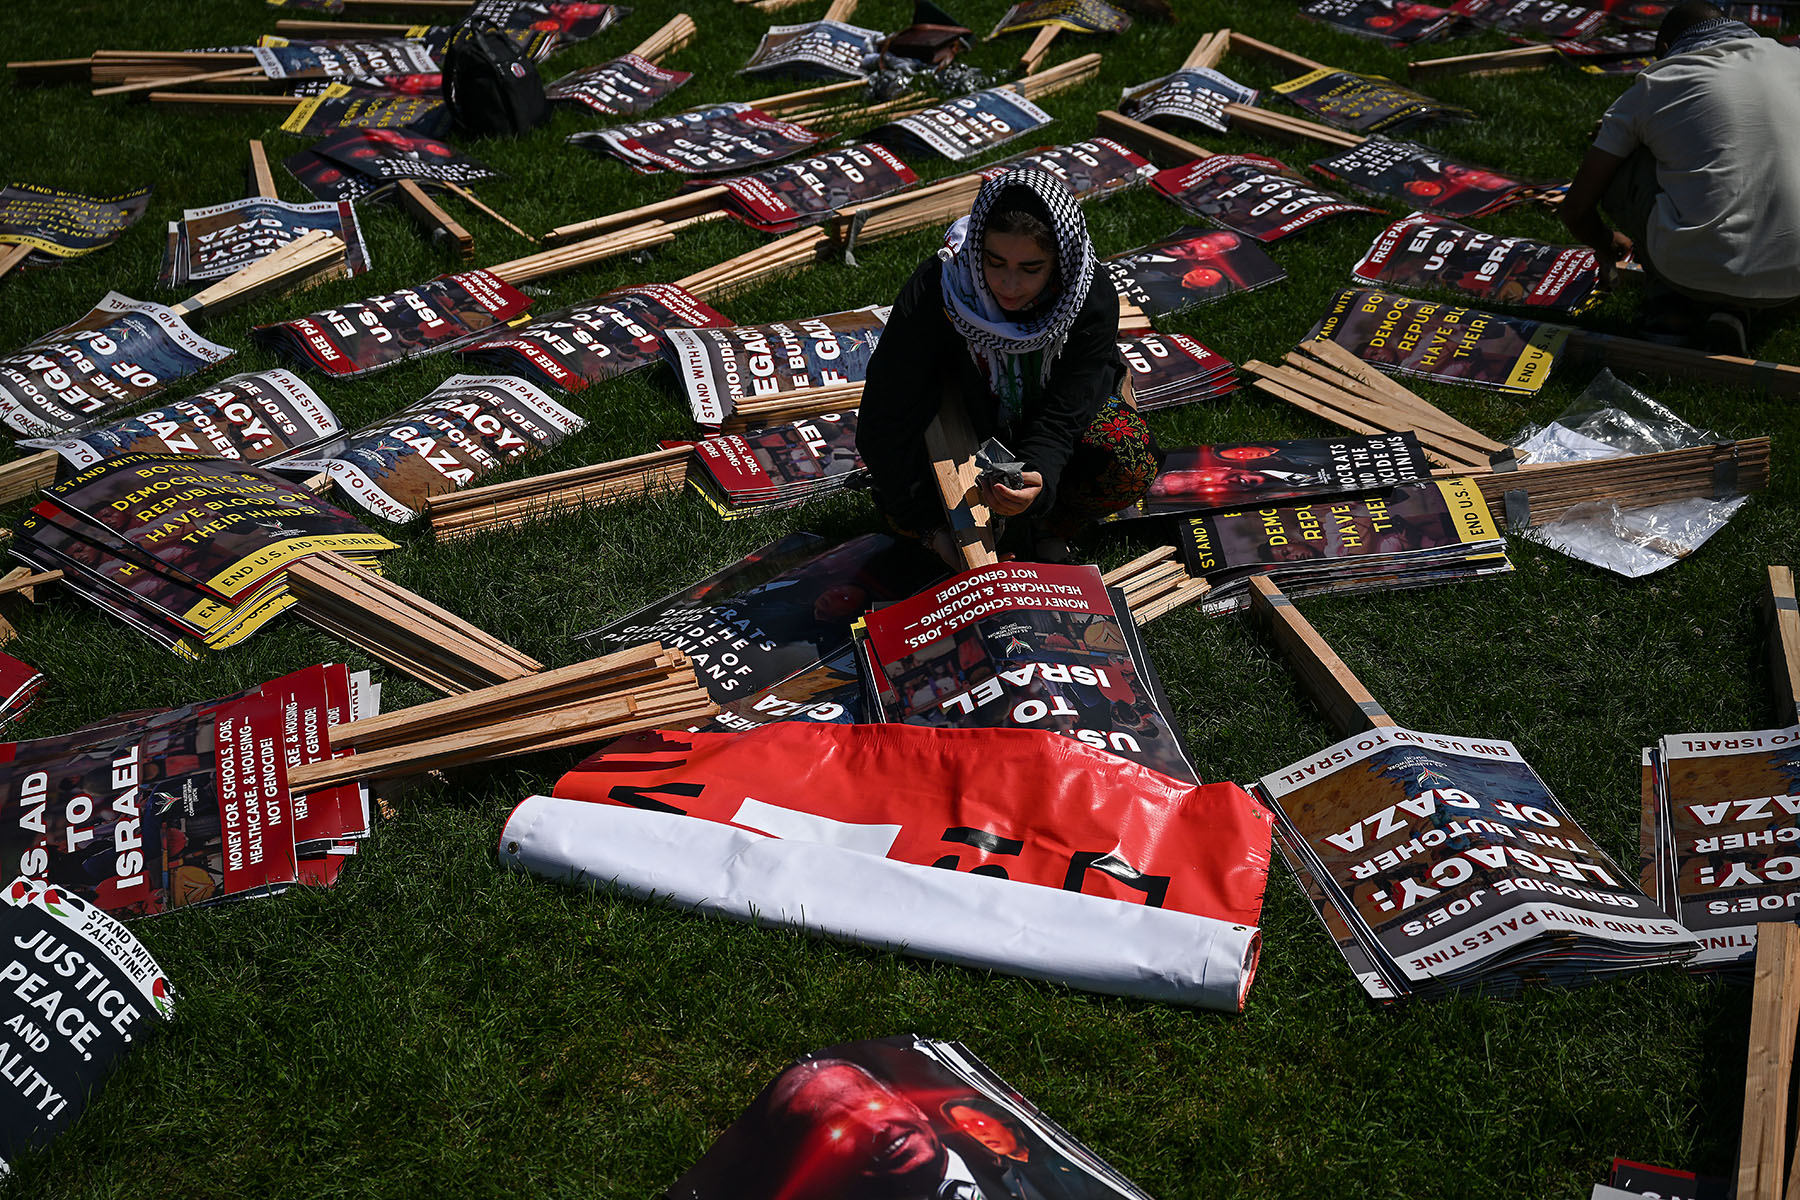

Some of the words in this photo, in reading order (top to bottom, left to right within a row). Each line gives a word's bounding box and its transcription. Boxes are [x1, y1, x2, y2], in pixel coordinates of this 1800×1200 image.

[966, 116, 995, 139] THE
[976, 111, 1011, 133] OF
[666, 148, 709, 167] END
[826, 156, 865, 184] AID
[1280, 188, 1336, 215] END
[198, 218, 283, 244] GAZA
[1464, 234, 1495, 252] TO
[1370, 238, 1392, 264] FREE
[462, 281, 478, 294] FOR
[485, 278, 502, 290] NOT
[474, 292, 499, 312] MONEY
[660, 298, 677, 310] FOR
[680, 294, 698, 306] NOT
[158, 312, 180, 328] AID
[358, 307, 393, 344] U.S.
[570, 313, 606, 332] TO
[674, 309, 704, 326] MONEY
[1315, 316, 1339, 342] TAND
[1398, 304, 1440, 351] REPUBL
[178, 330, 197, 349] U.S.
[310, 336, 341, 362] FREE
[519, 328, 576, 356] END
[572, 326, 612, 360] U.S.
[799, 318, 841, 360] GAZA
[1420, 326, 1454, 366] HAVE
[1453, 320, 1488, 359] THEIR
[112, 360, 158, 388] OF
[539, 357, 568, 380] FREE
[689, 347, 705, 380] WITH
[718, 342, 744, 399] ENOCIDE
[1116, 343, 1152, 374] AID
[1518, 362, 1538, 384] END
[88, 372, 129, 400] THE
[696, 383, 715, 419] STAND
[256, 396, 298, 436] JOE'S
[279, 378, 332, 431] PALESTINE
[488, 378, 519, 390] WITH
[516, 385, 582, 430] PALESTINE
[136, 412, 200, 454] GAZ
[350, 425, 395, 440] OF
[501, 406, 549, 440] JOE'S
[75, 448, 94, 462] TO
[389, 425, 479, 488] GAZA
[414, 412, 501, 470] BUTCHER
[1368, 440, 1386, 450] OF
[136, 463, 200, 482] BOTH
[742, 454, 760, 476] JOBS,
[1351, 448, 1371, 468] THE
[54, 466, 97, 494] STAND
[98, 456, 145, 476] WITH
[112, 474, 235, 513] DEMOCRATS
[243, 472, 260, 482] &
[136, 482, 278, 523] REPUBLICANS
[344, 470, 364, 488] TO
[362, 489, 404, 519] ISRAEL
[1455, 489, 1475, 510] U.S.
[146, 506, 206, 544] HAVE
[208, 494, 277, 514] BLOOD
[278, 491, 312, 504] ON
[182, 512, 246, 546] THEIR
[250, 504, 321, 521] HANDS!
[1330, 504, 1363, 548] HAVE
[1364, 497, 1393, 533] THEI
[1464, 512, 1486, 536] END
[221, 564, 256, 588] END
[258, 550, 286, 566] U.S.
[288, 541, 313, 552] AID
[312, 538, 336, 548] TO
[336, 536, 386, 548] ISRAEL
[1194, 527, 1216, 569] STAND
[935, 568, 1008, 604] GENOCIDE!
[996, 582, 1082, 596] HEALTHCARE,
[1010, 568, 1039, 581] NOT
[986, 586, 995, 597] &
[1014, 596, 1042, 608] FOR
[1044, 598, 1089, 610] MONEY
[198, 602, 222, 619] EN
[920, 588, 984, 627] HOUSING
[942, 597, 1014, 630] SCHOOLS,
[661, 604, 777, 652] DEMOCRATS
[708, 618, 750, 650] THE
[904, 626, 943, 650] JOBS,
[601, 630, 740, 692] PALESTINIANS
[622, 617, 719, 649] GENOCIDE
[720, 652, 752, 678] OF
[941, 662, 1113, 716] ISRAEL
[286, 702, 298, 732] HOUSING
[752, 692, 844, 720] GAZA
[1010, 696, 1080, 724] TO
[220, 716, 235, 748] JOBS,
[239, 725, 254, 766] HOUSING
[286, 732, 298, 744] &
[304, 706, 320, 754] GENOCIDE!
[1069, 729, 1142, 753] U.S.
[1356, 732, 1389, 754] TO
[1394, 731, 1424, 743] AID
[1428, 736, 1468, 754] U.S.
[1682, 737, 1763, 752] ISRAEL
[1471, 741, 1510, 757] END
[222, 748, 238, 800] SCHOOLS,
[244, 768, 256, 780] &
[260, 737, 278, 798] GENOCIDE!
[1279, 749, 1354, 786] ISRAEL
[19, 771, 48, 834] AID
[112, 746, 144, 890] ISRAEL
[228, 800, 240, 827] FOR
[268, 798, 282, 826] NOT
[1495, 798, 1561, 829] OF
[1687, 794, 1800, 826] AZA
[66, 794, 95, 854] TO
[244, 780, 263, 865] HEALTHCARE,
[1323, 786, 1481, 852] GAZA
[230, 828, 244, 872] MONEY
[1350, 820, 1514, 882] BUTCHER
[1517, 828, 1590, 856] THE
[1367, 845, 1621, 913] LEGACY:
[1492, 876, 1640, 909] GENOCIDE
[1401, 888, 1488, 938] JOE'S
[1542, 908, 1602, 930] WITH
[1604, 918, 1680, 938] STAND
[80, 922, 148, 984] PALESTINE!
[87, 910, 132, 944] STAND
[130, 940, 159, 977] WITH
[1410, 908, 1539, 972] PALESTINE
[13, 928, 142, 1044] JUSTICE,
[0, 959, 102, 1062] PEACE,
[4, 1013, 50, 1054] AND
